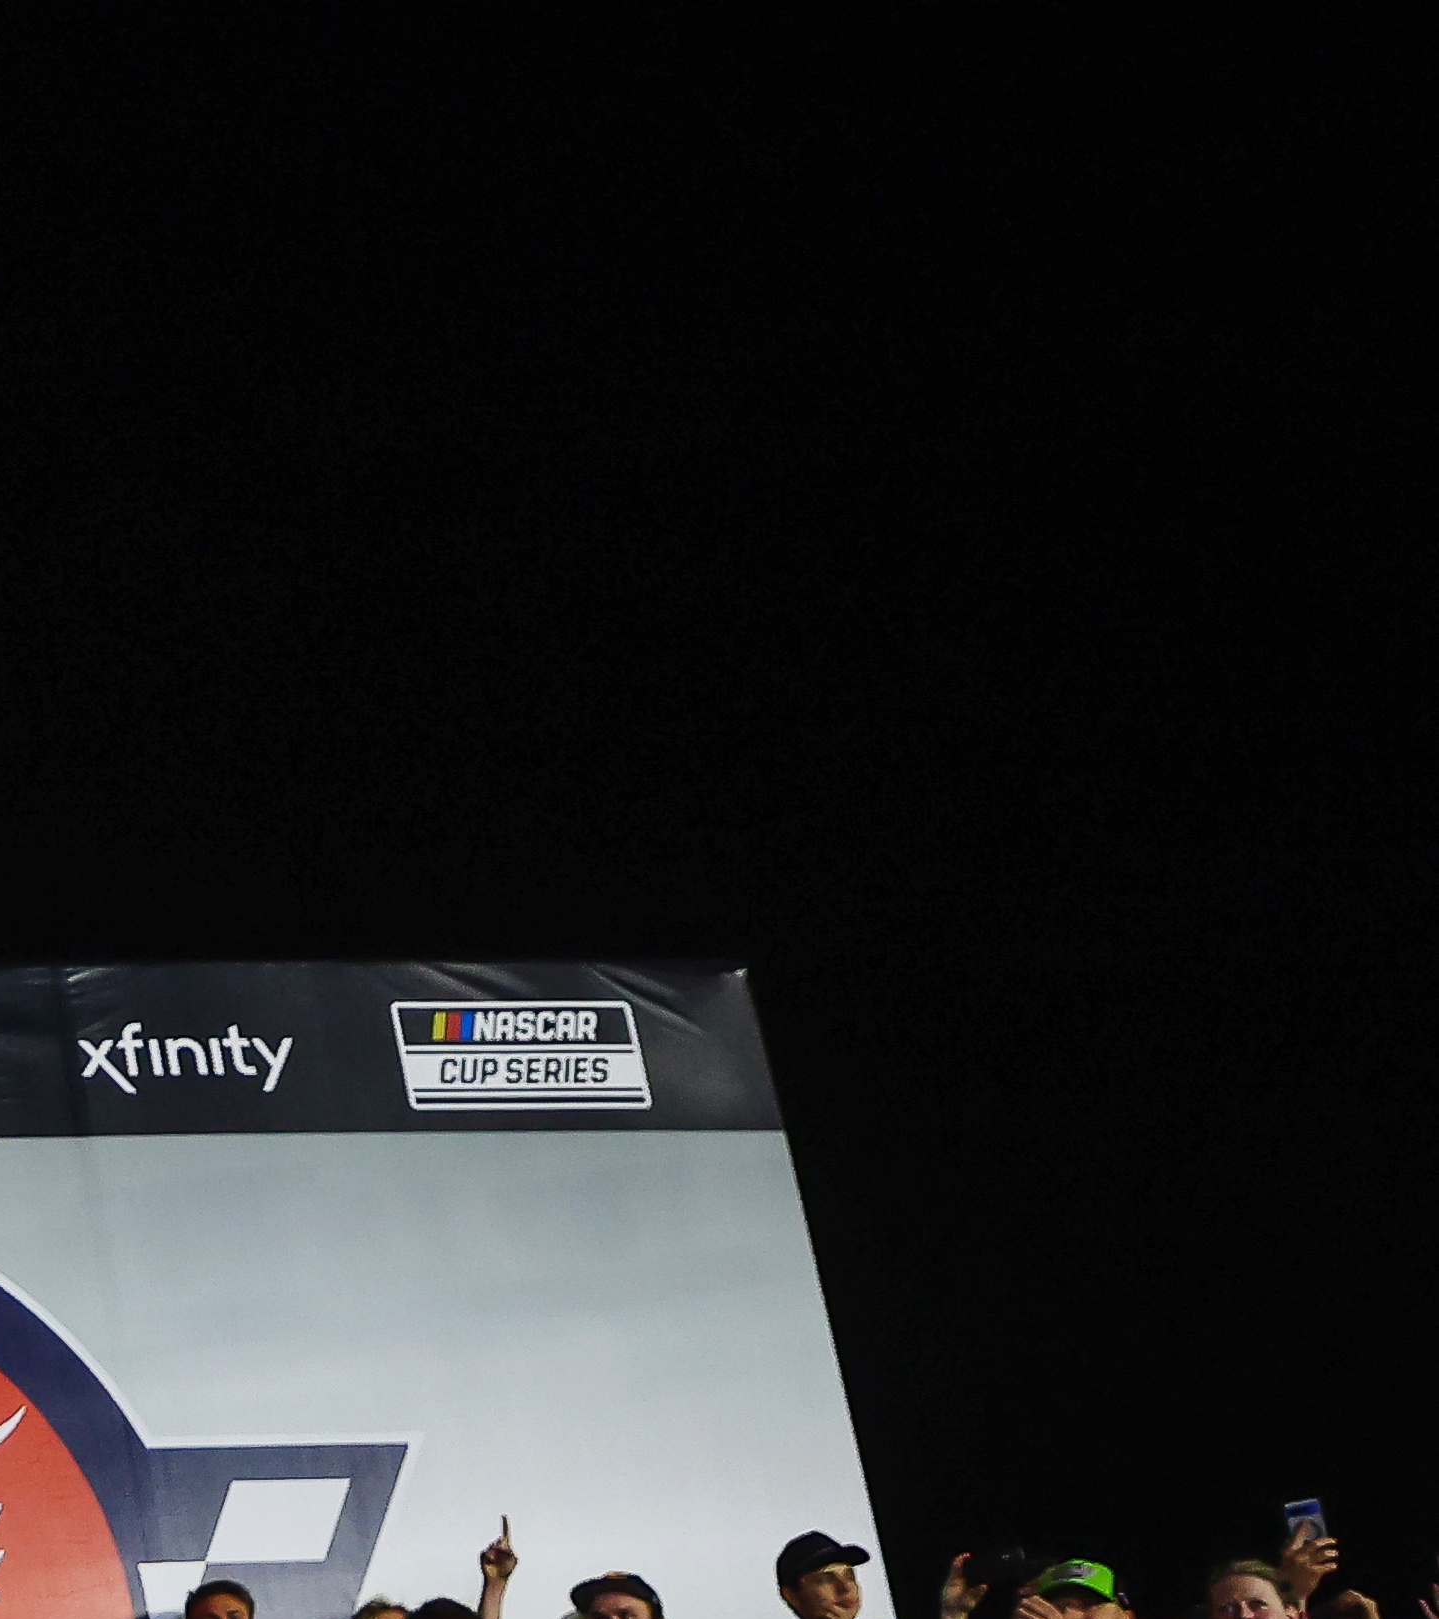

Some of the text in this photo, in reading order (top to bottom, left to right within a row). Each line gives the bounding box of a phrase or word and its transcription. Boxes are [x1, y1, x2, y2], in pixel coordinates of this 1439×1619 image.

[472, 1010, 598, 1042] NASCAR
[80, 1022, 293, 1094] xfinity
[439, 1056, 610, 1086] CUP SERIES
